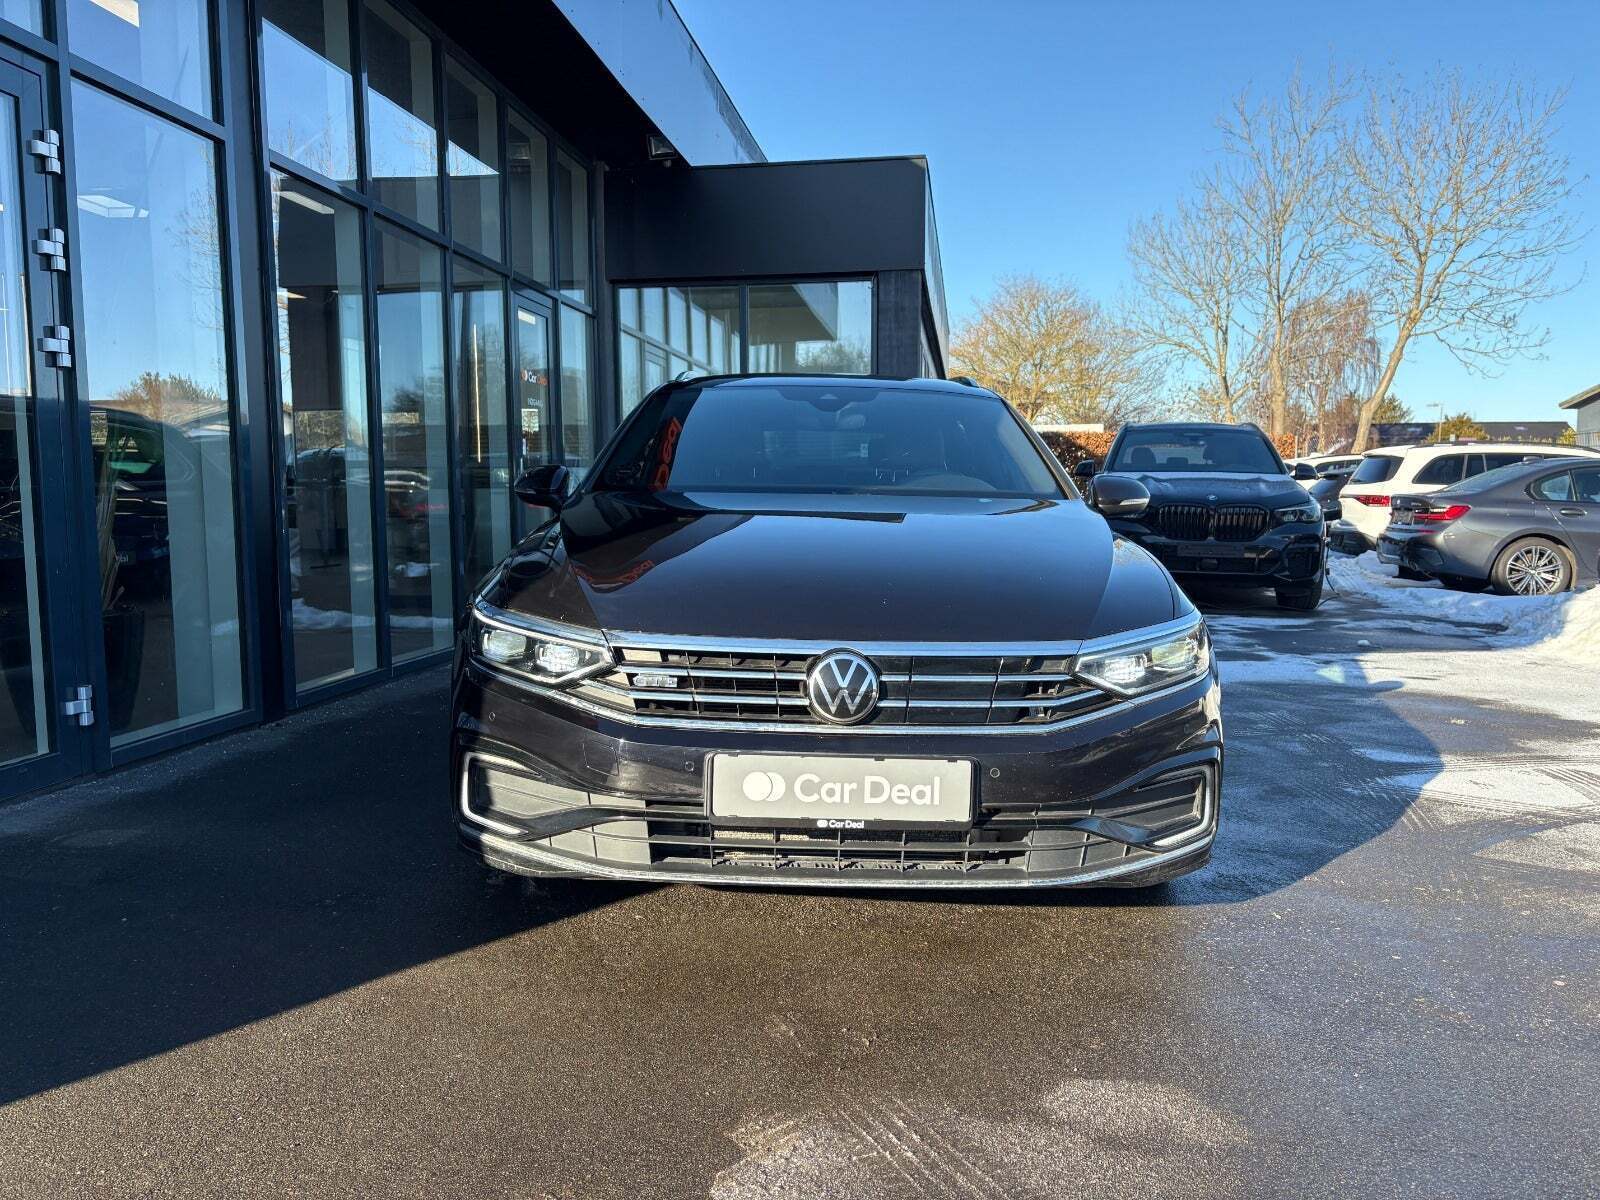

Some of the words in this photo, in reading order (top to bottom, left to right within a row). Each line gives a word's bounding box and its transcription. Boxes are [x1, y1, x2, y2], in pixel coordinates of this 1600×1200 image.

[793, 773, 857, 804] Car
[863, 775, 940, 806] Deal
[829, 820, 845, 829] Car
[845, 820, 865, 829] Deal
